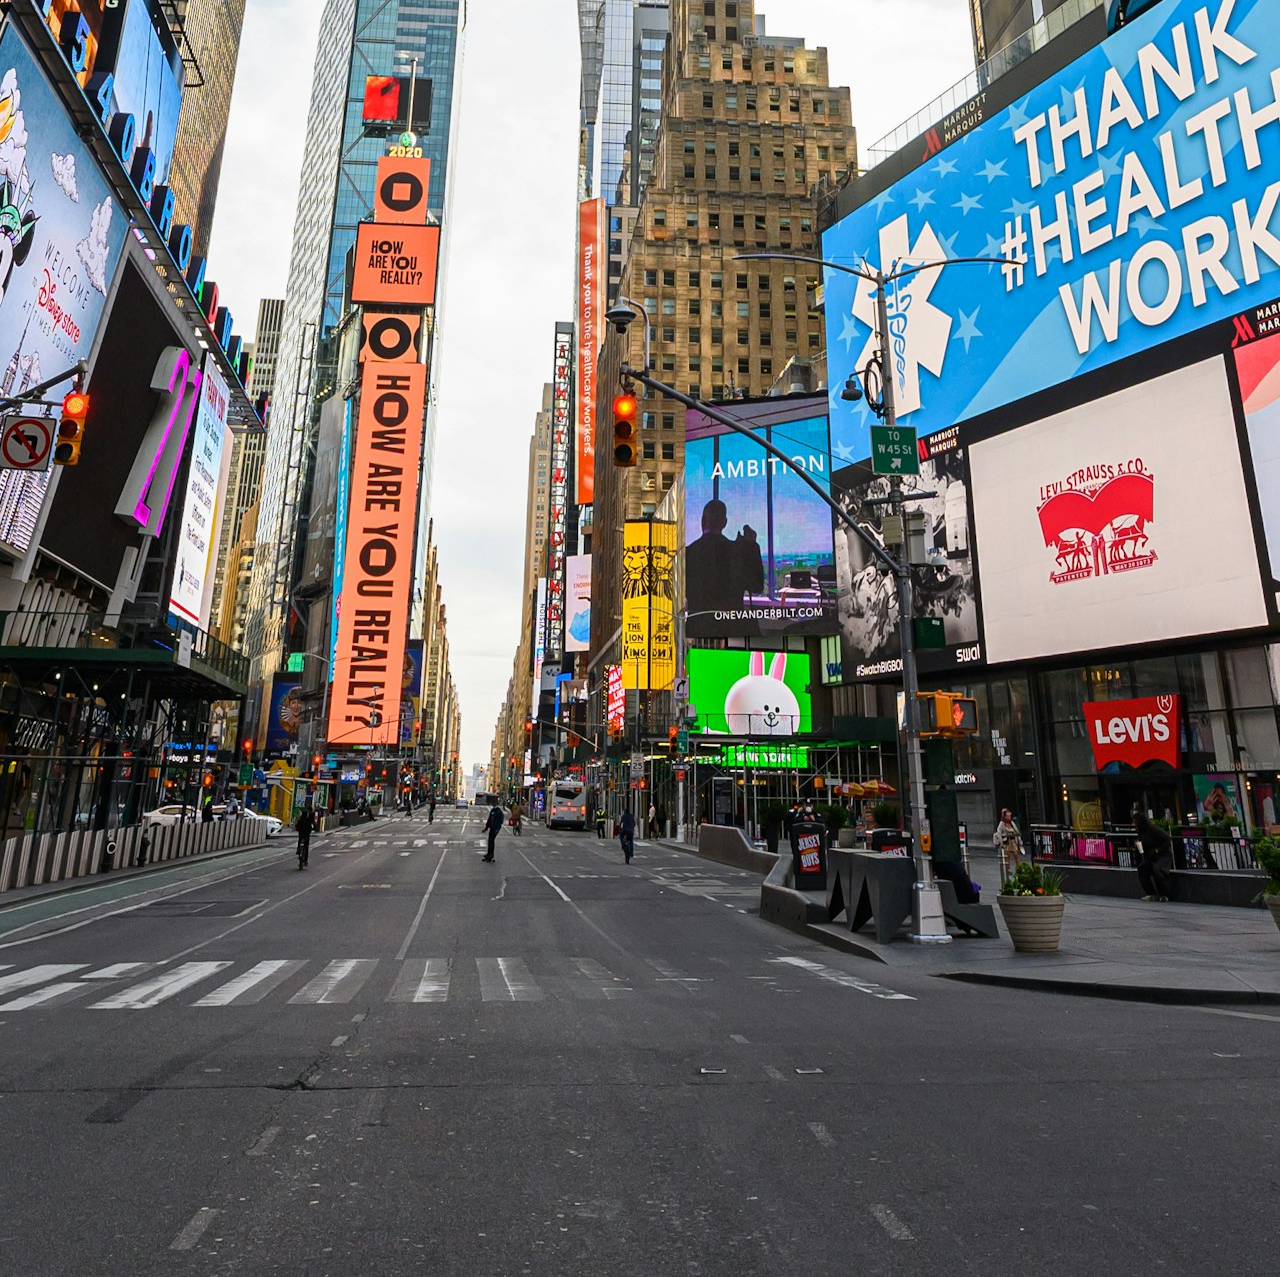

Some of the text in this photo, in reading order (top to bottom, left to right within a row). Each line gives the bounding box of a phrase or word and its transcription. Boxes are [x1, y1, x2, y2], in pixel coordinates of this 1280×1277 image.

[943, 94, 988, 129] MARRIOTT
[945, 109, 984, 142] MARQUIS
[388, 146, 423, 158] 2020
[371, 240, 404, 254] HOW
[368, 255, 417, 270] ARE YOU
[45, 239, 91, 311] WELCOME
[380, 270, 422, 285] REALLY?
[581, 243, 593, 457] Thank you to the healthcare workers.
[888, 431, 900, 442] TO
[929, 426, 960, 444] MARRIOTT
[878, 444, 913, 455] W 45 St
[930, 438, 958, 455] MARQUIS
[711, 452, 826, 481] AMBITION
[1040, 457, 1148, 501] LEVI STRAUSS & CO.
[344, 374, 412, 728] HOW ARE YOU REALLY?
[1114, 562, 1128, 571] MAY
[1135, 558, 1152, 567] 1873
[1055, 571, 1089, 583] PATENTED
[714, 607, 823, 621] ONEVANDERBILT.COM
[627, 622, 642, 631] THE
[624, 632, 644, 645] LION
[624, 645, 647, 660] KING
[633, 762, 643, 770] 25
[798, 833, 821, 850] JERSEY
[800, 852, 820, 868] BOYS
